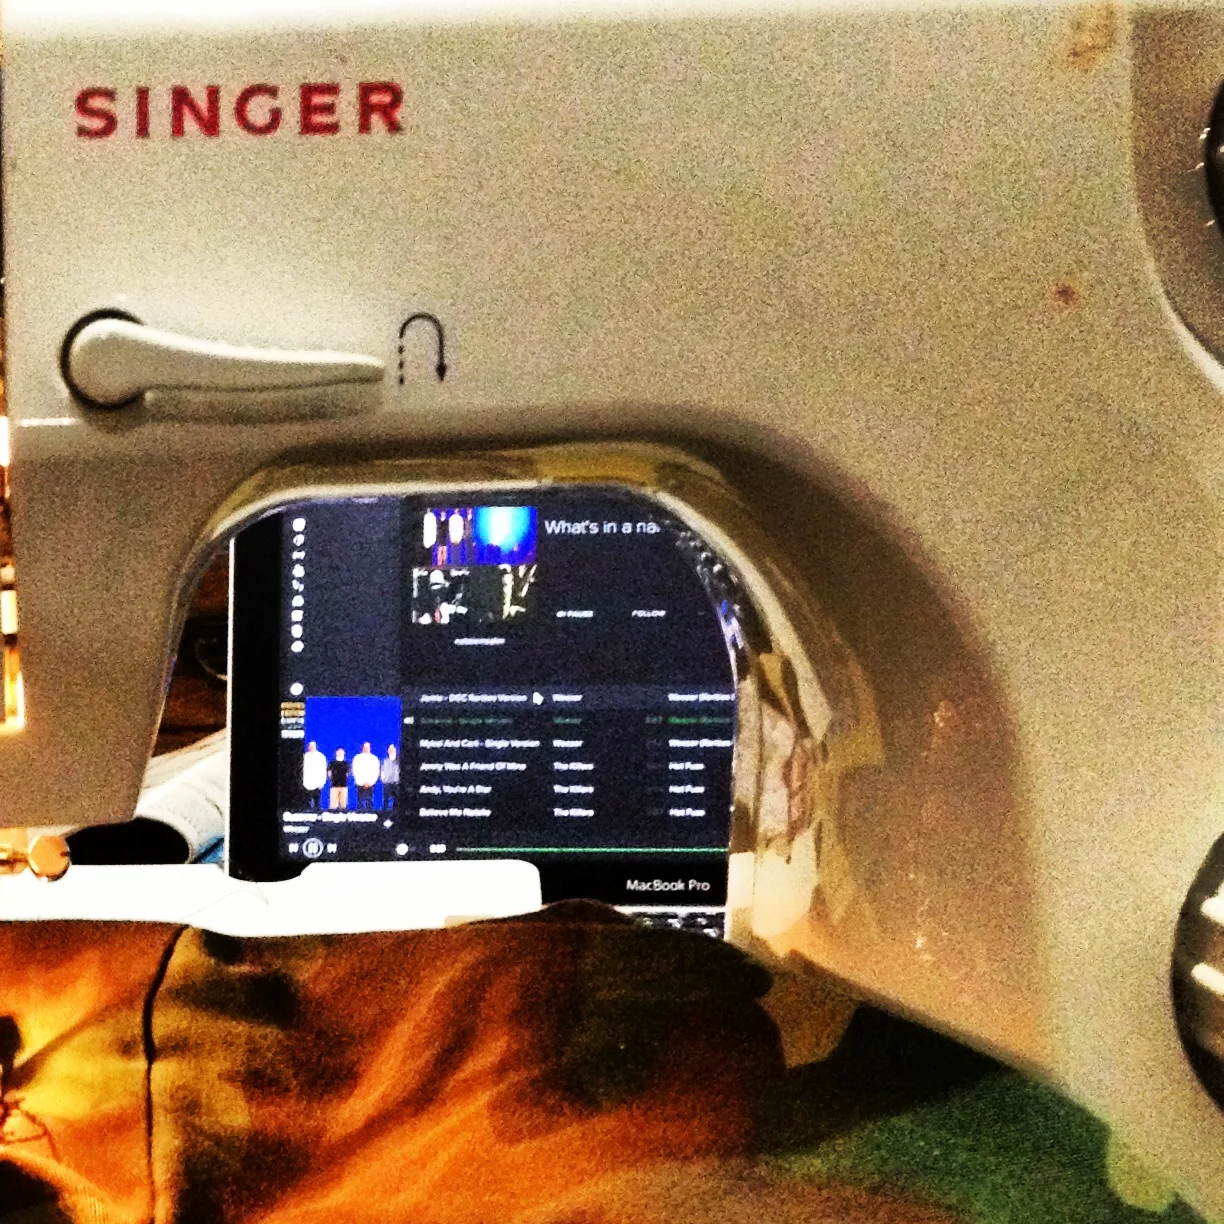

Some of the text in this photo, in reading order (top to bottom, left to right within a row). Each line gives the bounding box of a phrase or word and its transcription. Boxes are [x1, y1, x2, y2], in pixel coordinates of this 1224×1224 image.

[75, 81, 405, 140] SINGER
[544, 519, 661, 535] What's in a na
[626, 879, 711, 891] MacBook Pro
